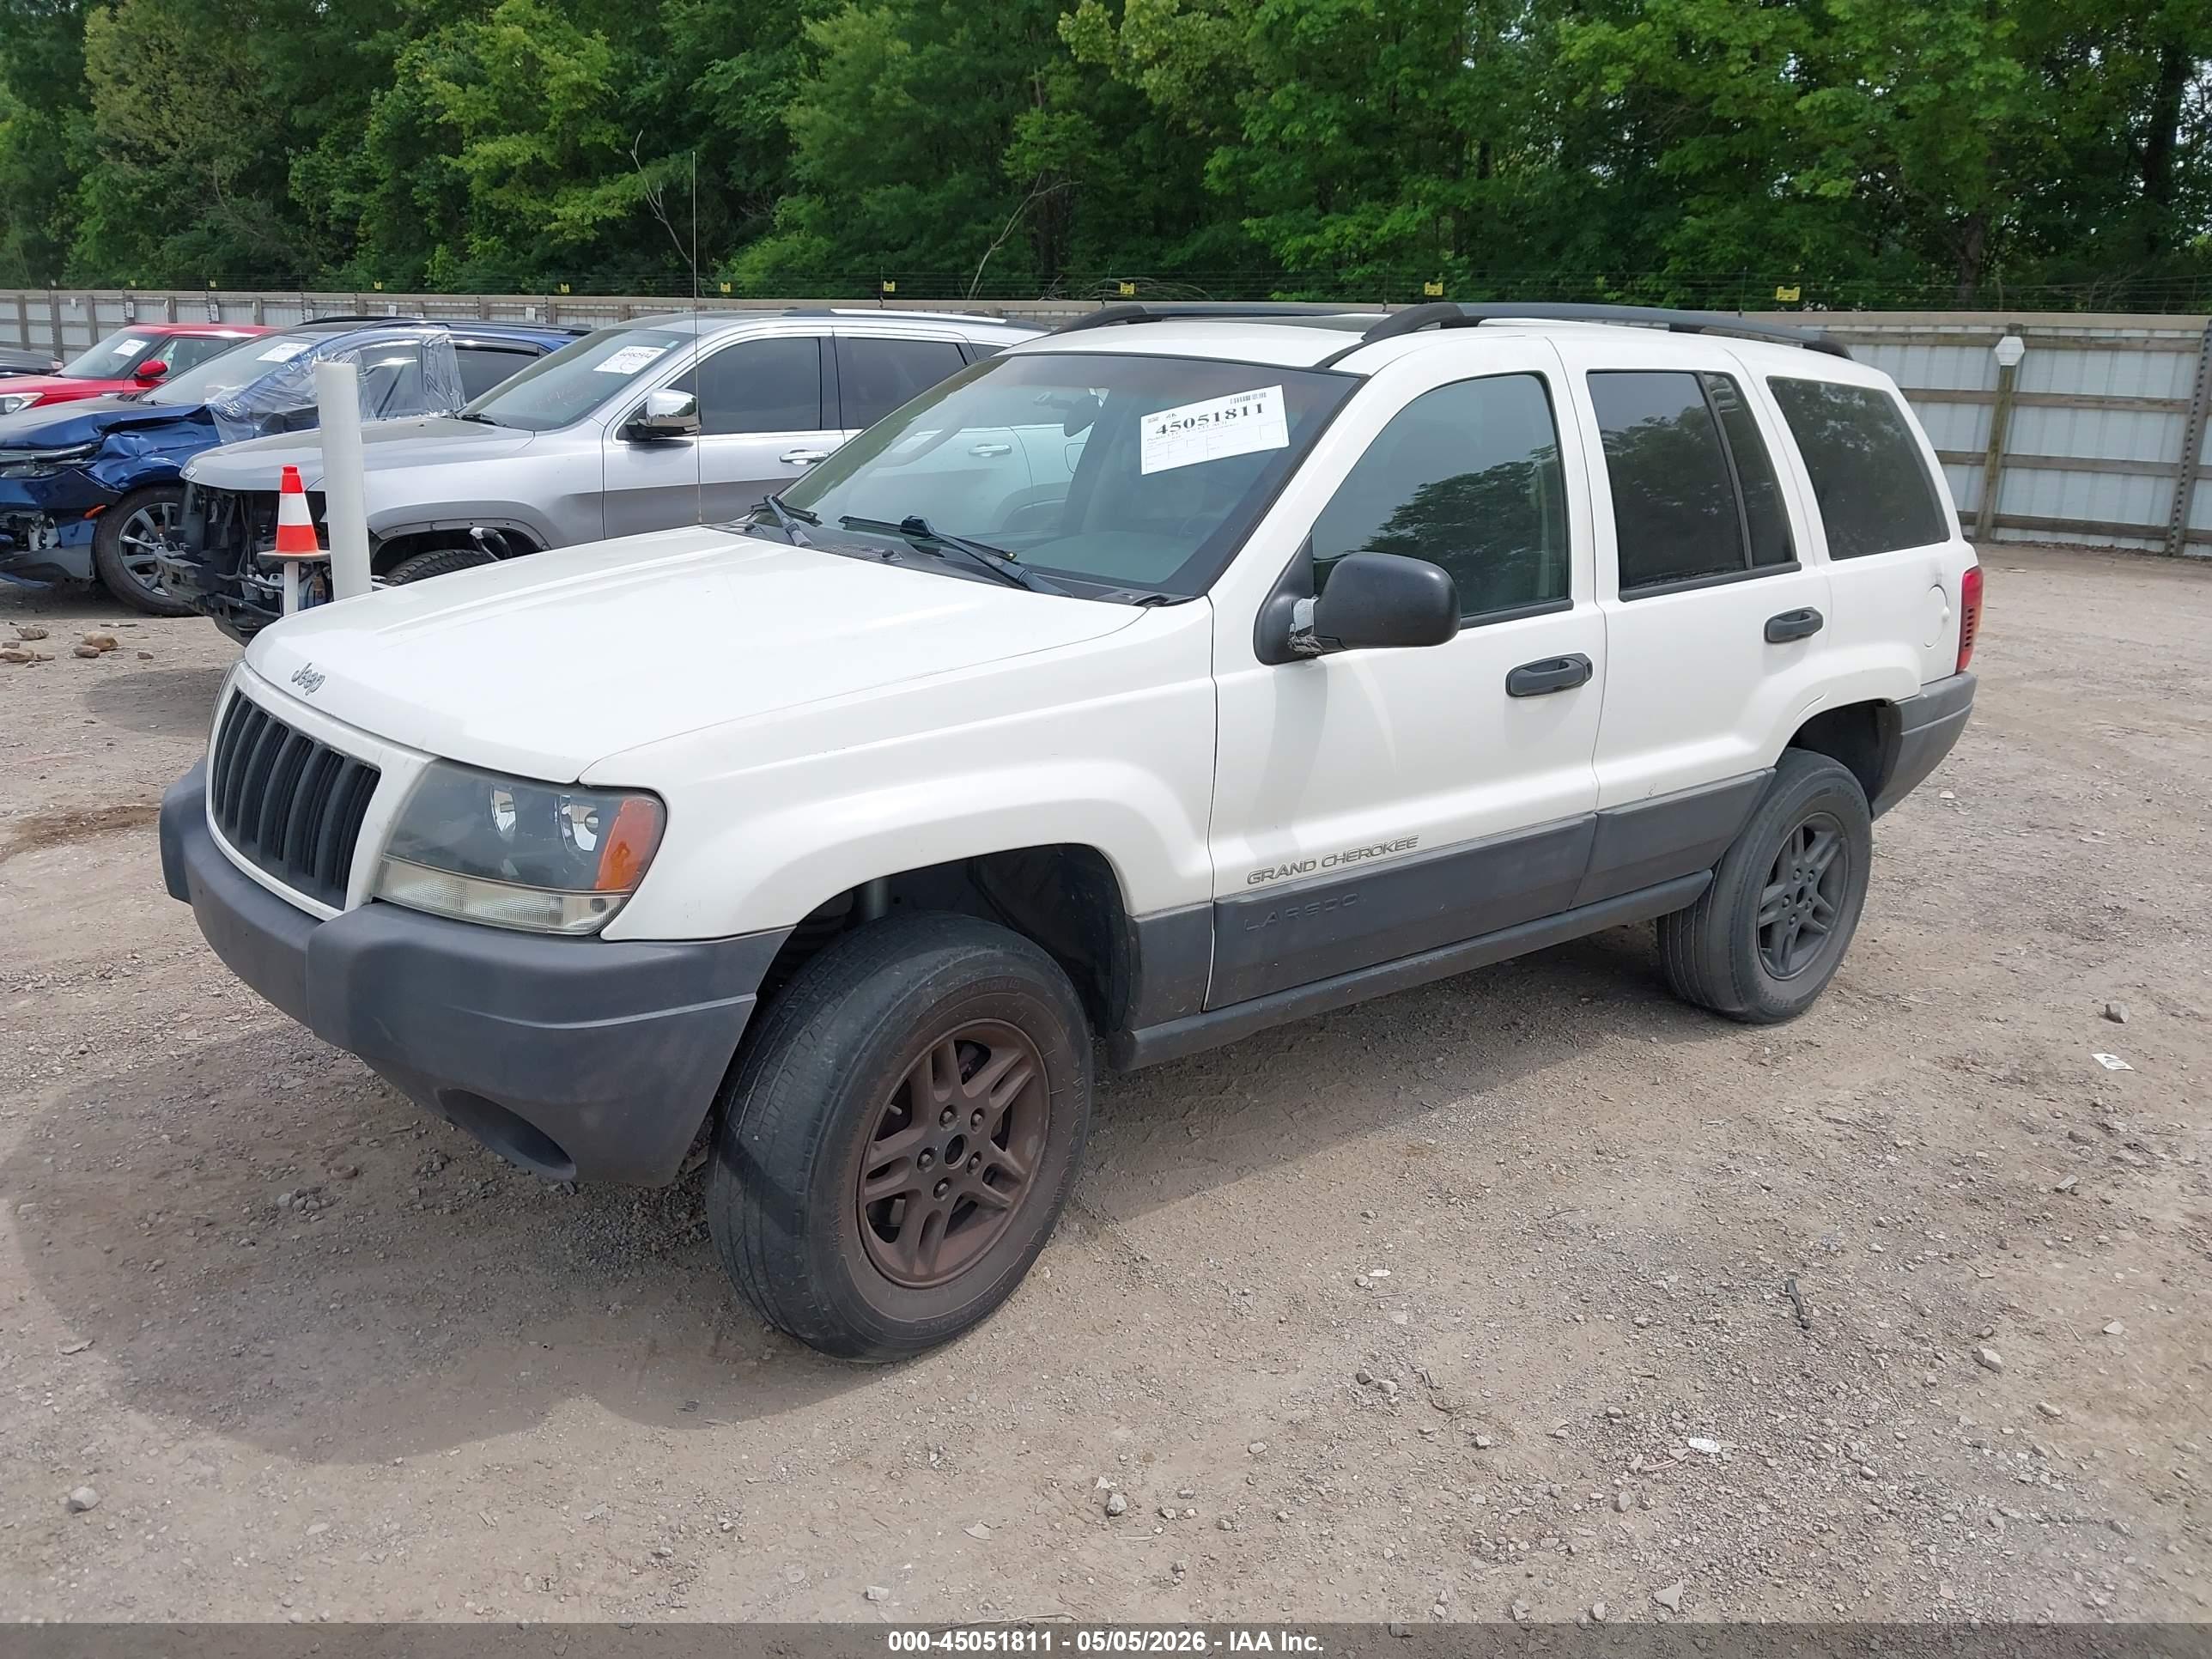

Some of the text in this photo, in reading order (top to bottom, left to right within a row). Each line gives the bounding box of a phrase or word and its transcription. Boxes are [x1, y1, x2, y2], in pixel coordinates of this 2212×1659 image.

[1155, 403, 1265, 434] 45051811
[291, 662, 325, 696] Jeep
[1247, 835, 1419, 885] GRAND CHEROKEE
